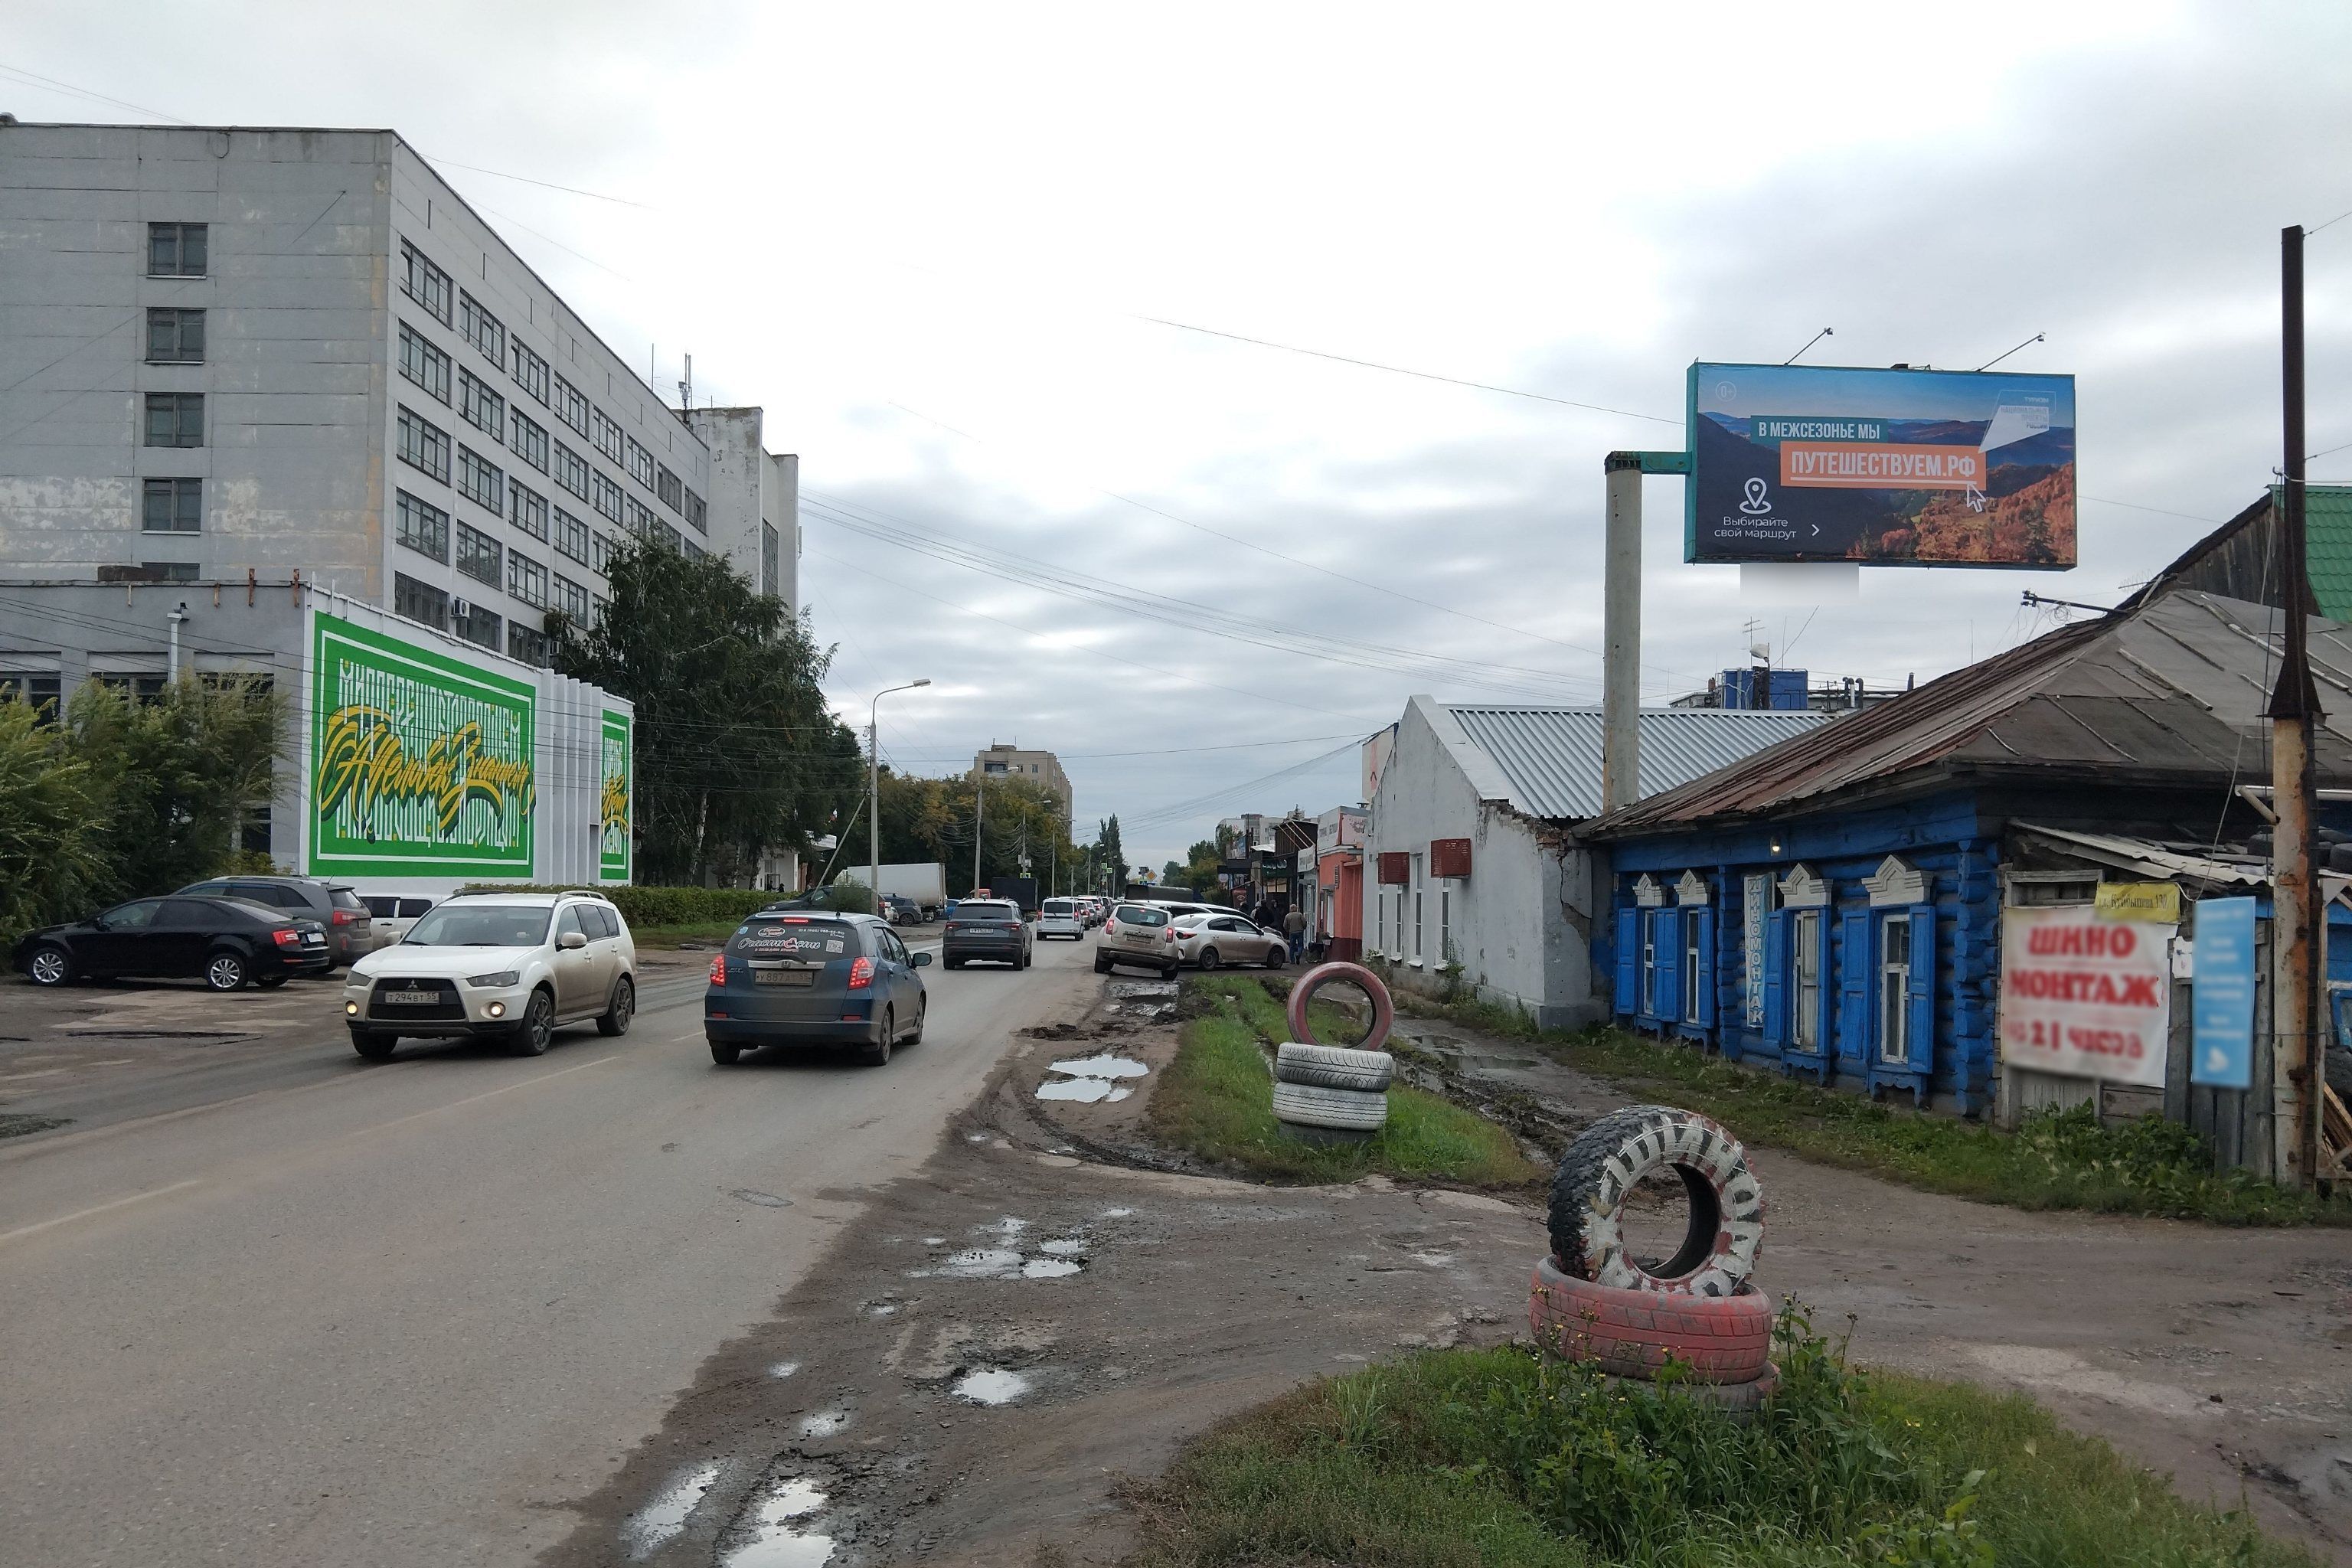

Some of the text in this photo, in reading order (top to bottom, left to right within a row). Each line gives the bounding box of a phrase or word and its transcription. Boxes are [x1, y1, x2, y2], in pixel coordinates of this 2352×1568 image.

[1758, 421, 1880, 439] В МЕЖСЕЗОНЬЕ МЫ
[1791, 450, 1976, 477] ПУТЕШЕСТВУЕМ.РФ
[1723, 516, 1788, 528] Выбирайте
[1713, 528, 1797, 541] свой маршрут
[2027, 925, 2137, 959] ШИНО
